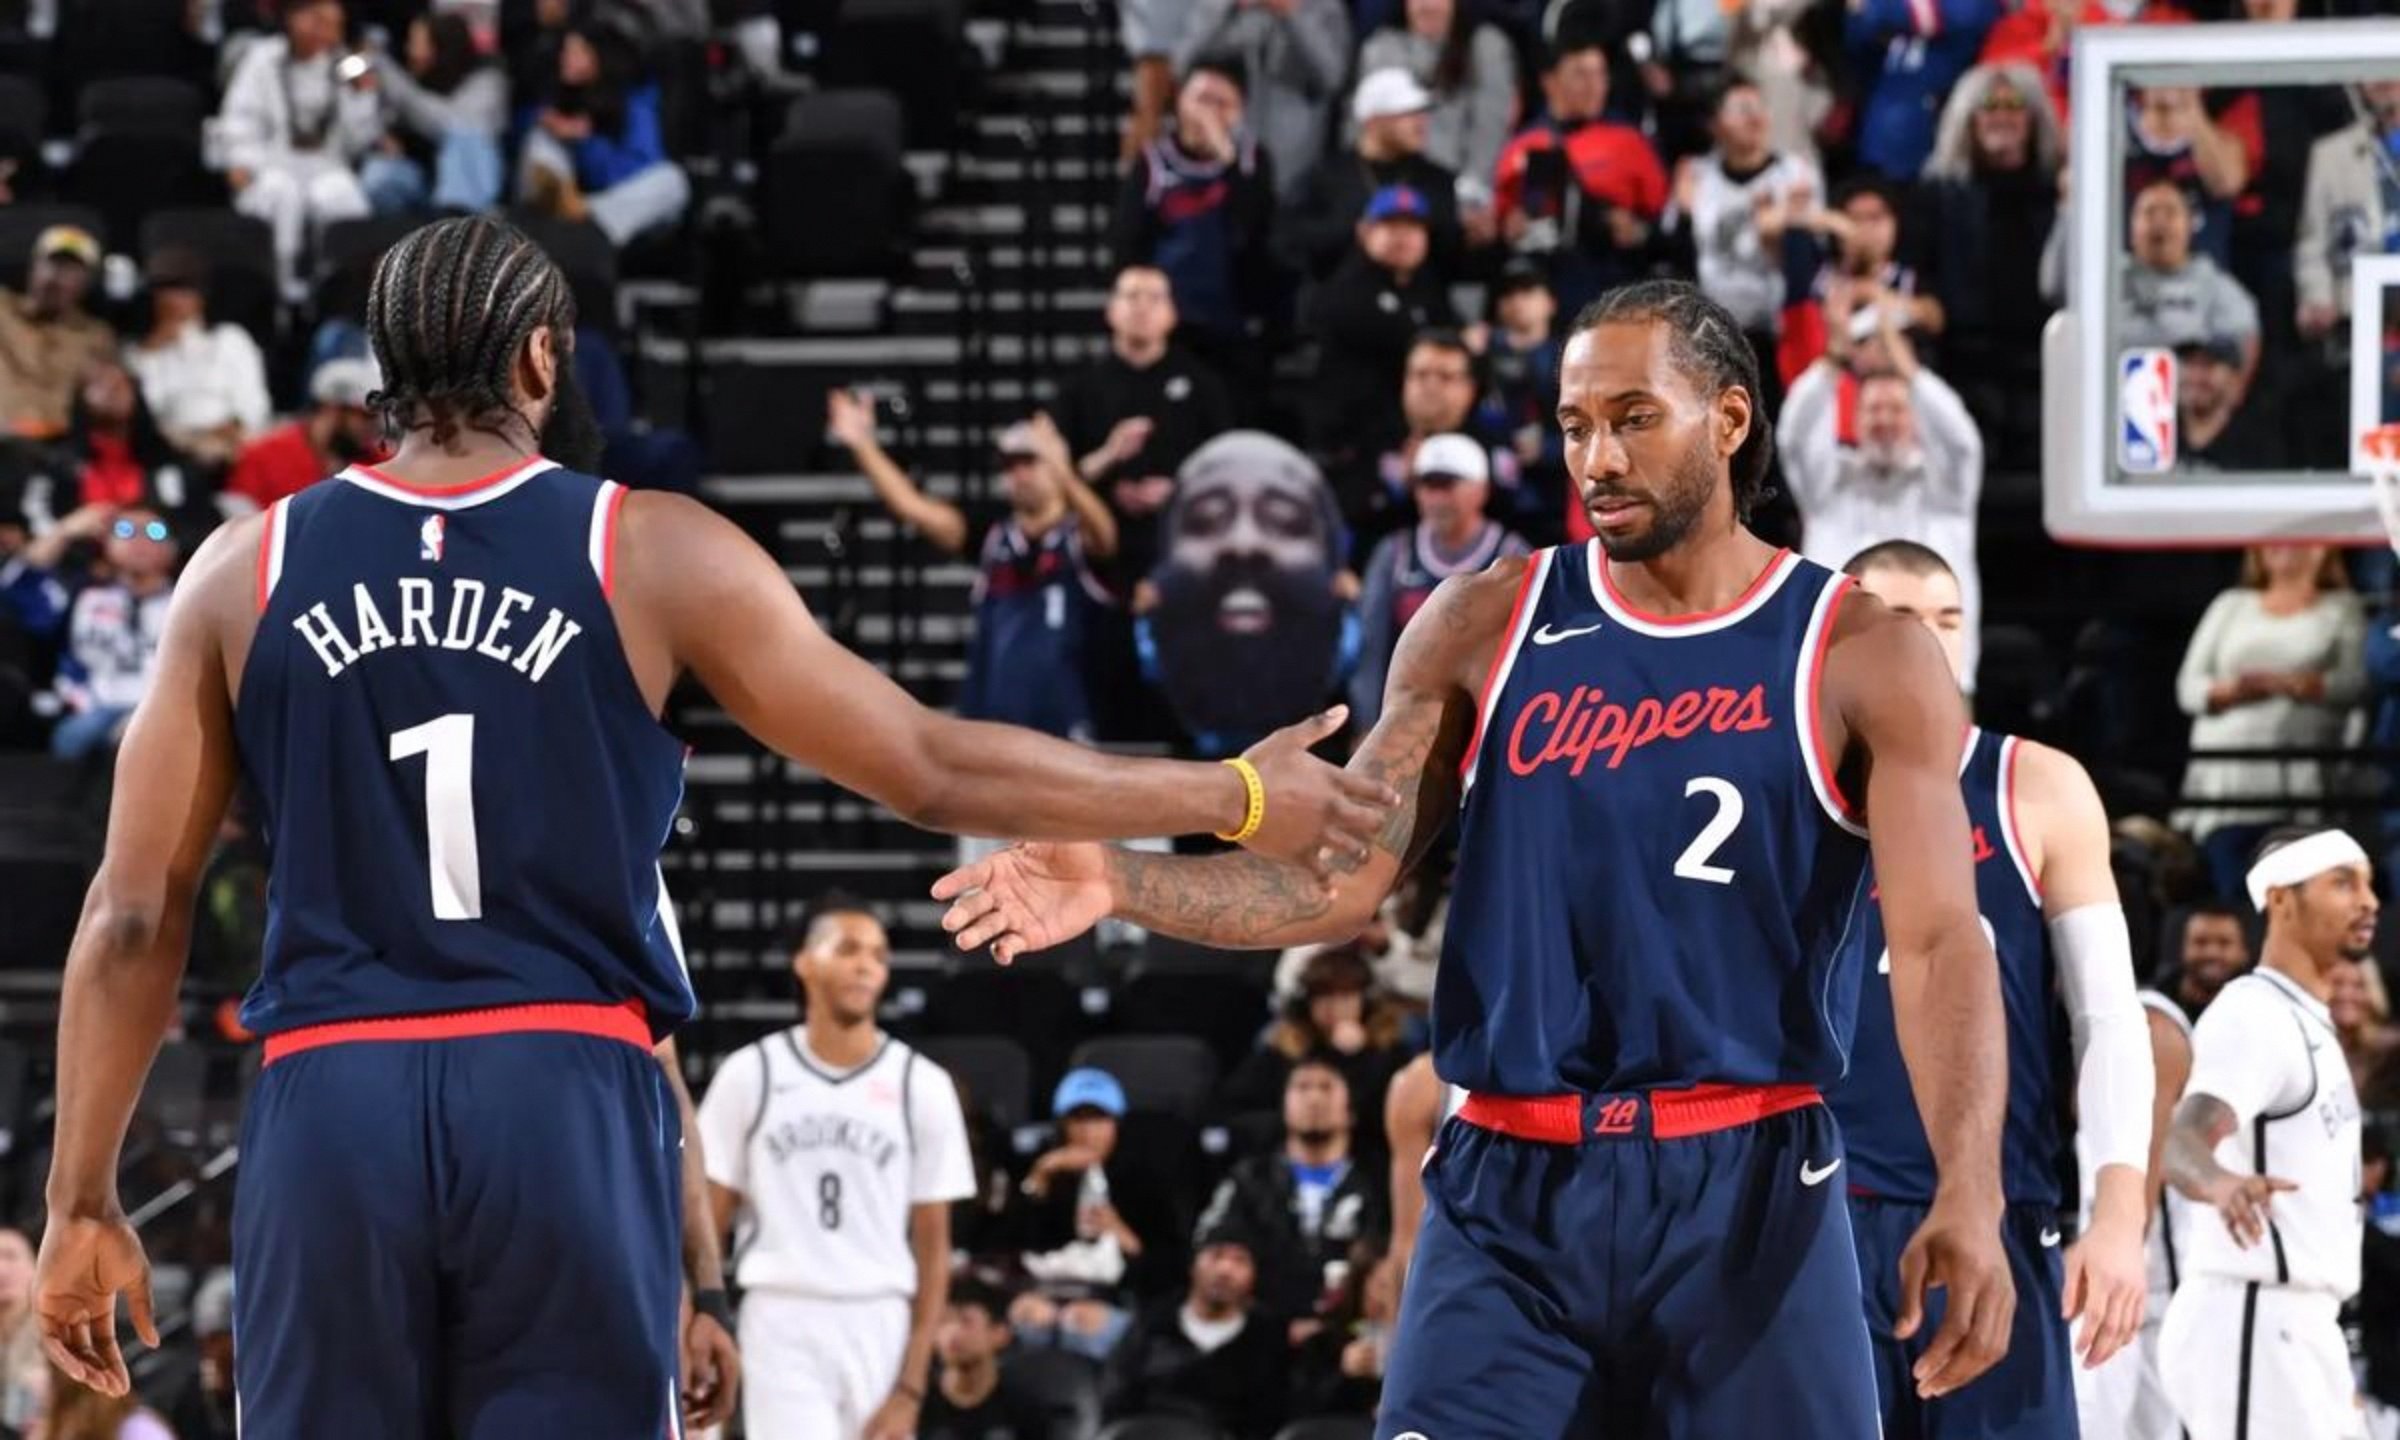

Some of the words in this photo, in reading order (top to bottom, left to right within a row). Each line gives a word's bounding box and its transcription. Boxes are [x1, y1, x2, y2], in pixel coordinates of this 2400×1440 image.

[292, 577, 582, 683] HARDEN
[1507, 684, 1773, 777] Clippers
[390, 714, 482, 919] 1
[1673, 776, 1744, 885] 2
[1594, 1097, 1638, 1134] LA
[819, 1172, 841, 1230] 8
